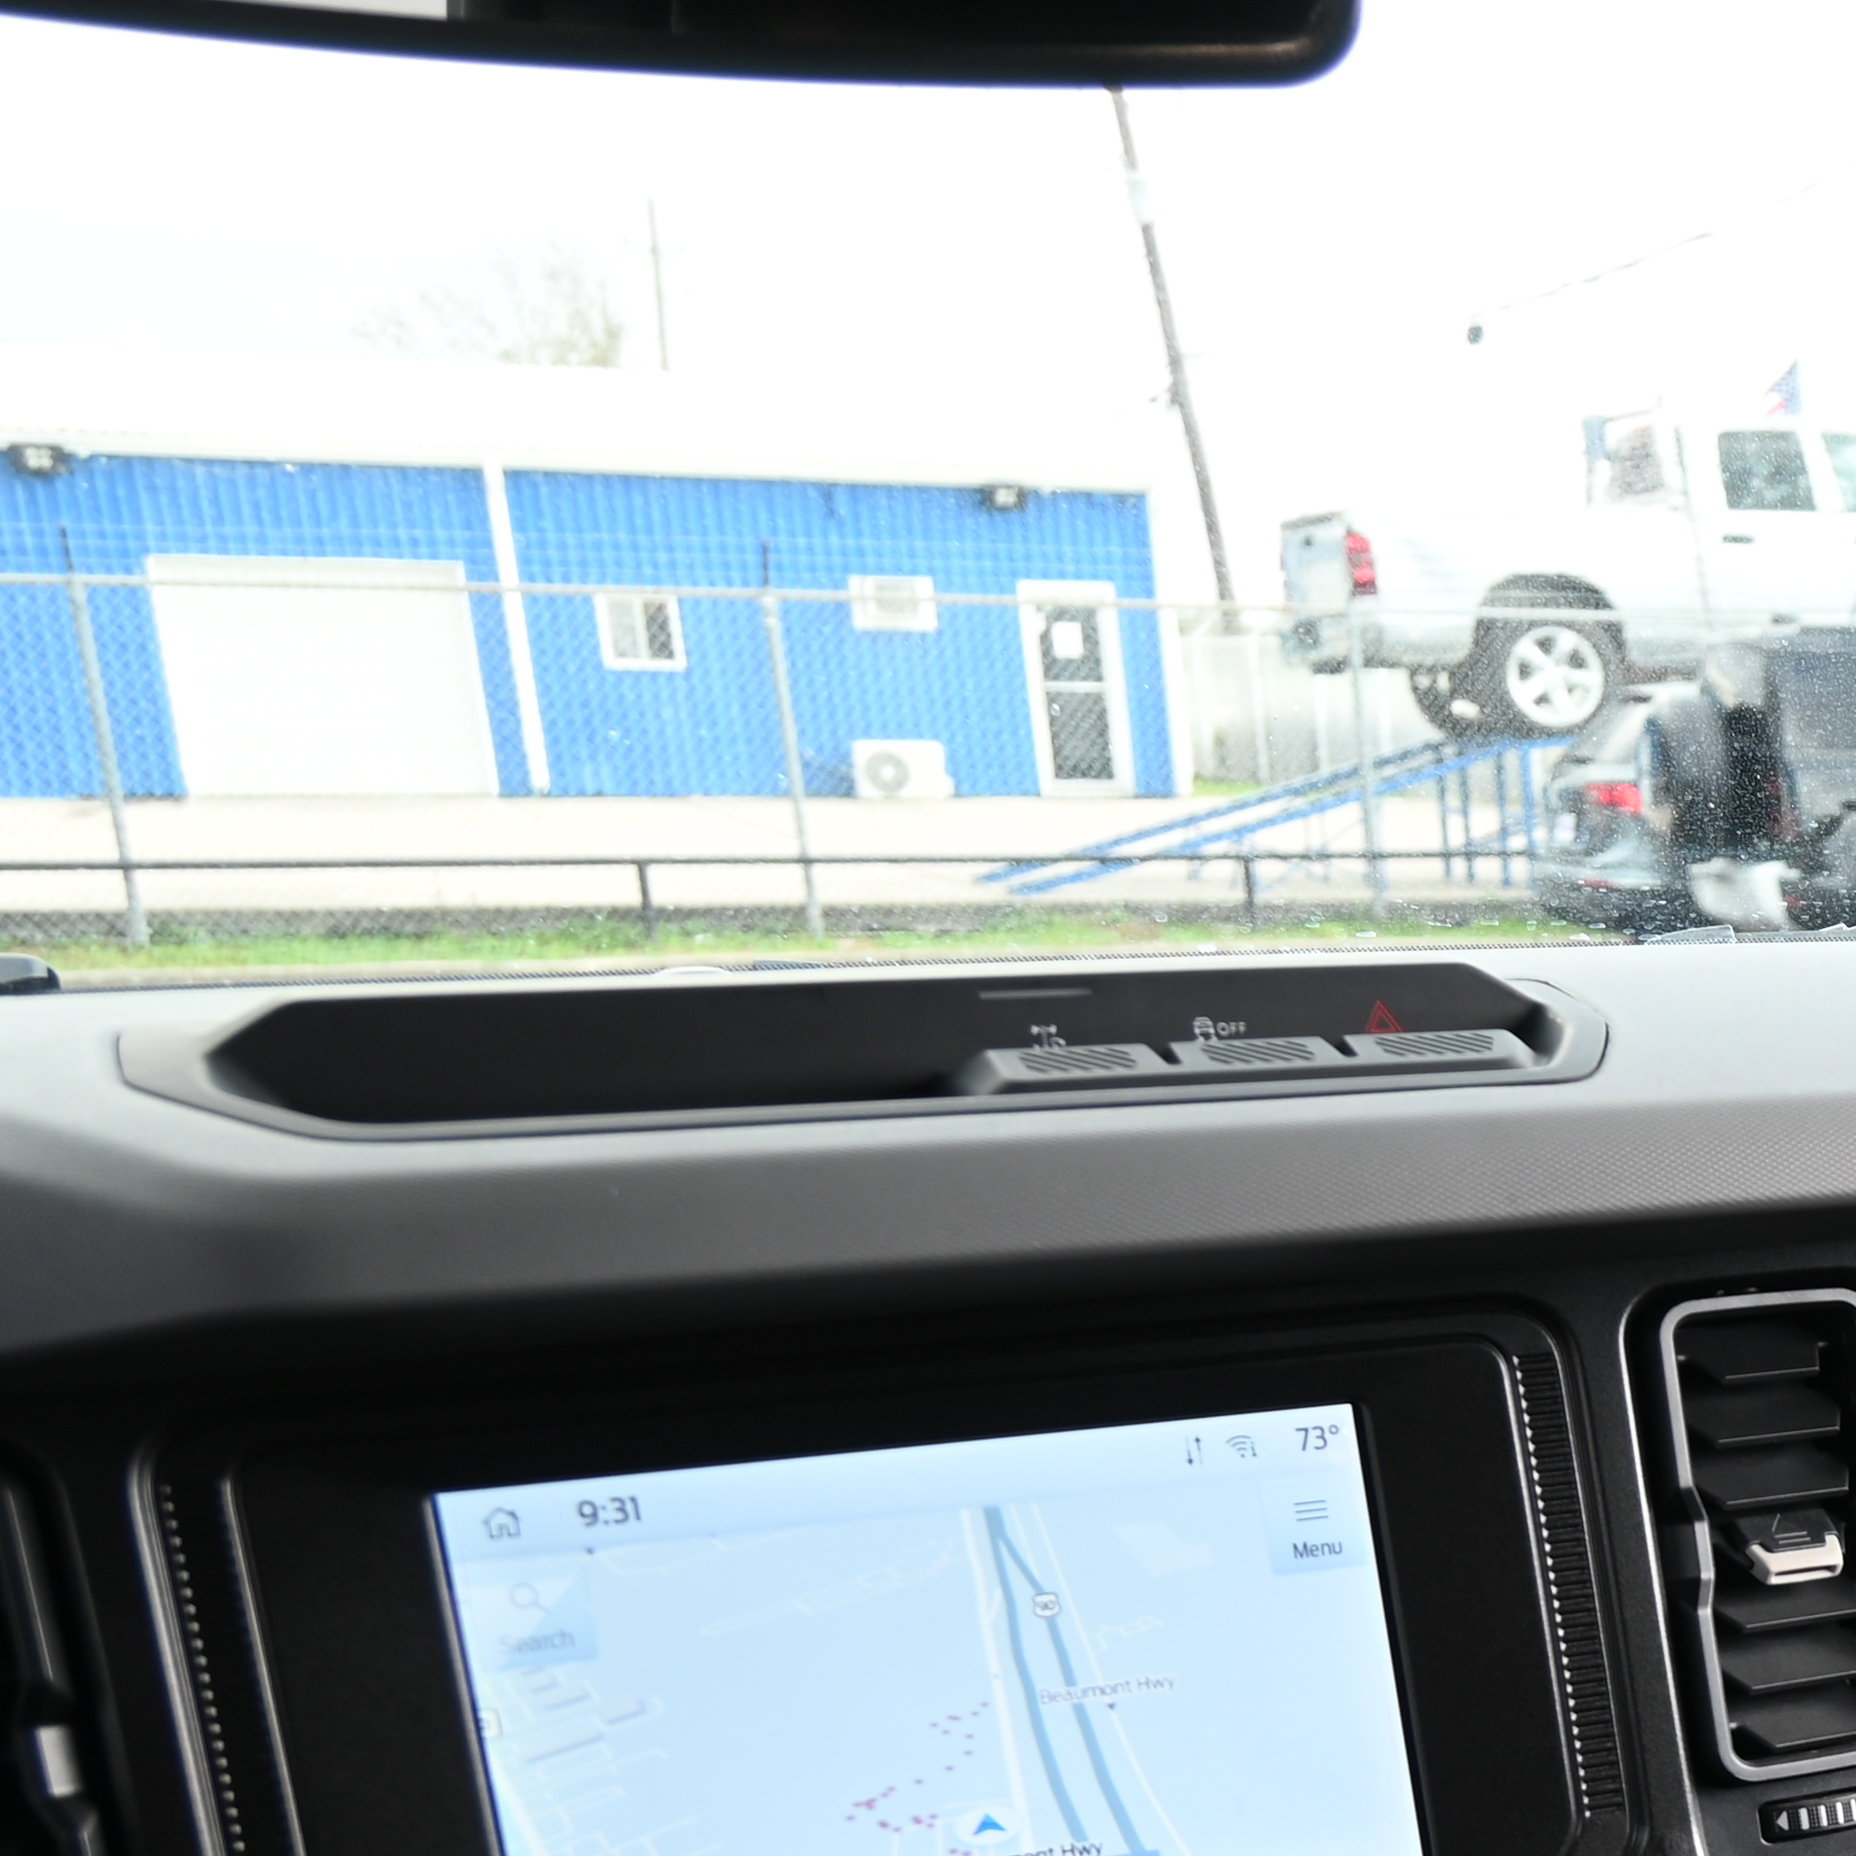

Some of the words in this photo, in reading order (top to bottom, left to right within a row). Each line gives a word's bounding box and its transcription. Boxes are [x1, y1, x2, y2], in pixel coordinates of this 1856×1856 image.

[1216, 1021, 1247, 1037] OFF
[1294, 1423, 1340, 1452] 73°
[576, 1495, 642, 1527] 9:31
[1292, 1541, 1343, 1560] Menu
[498, 1629, 577, 1653] Search
[1038, 1679, 1133, 1705] Beaumont
[1136, 1675, 1176, 1692] Hwy
